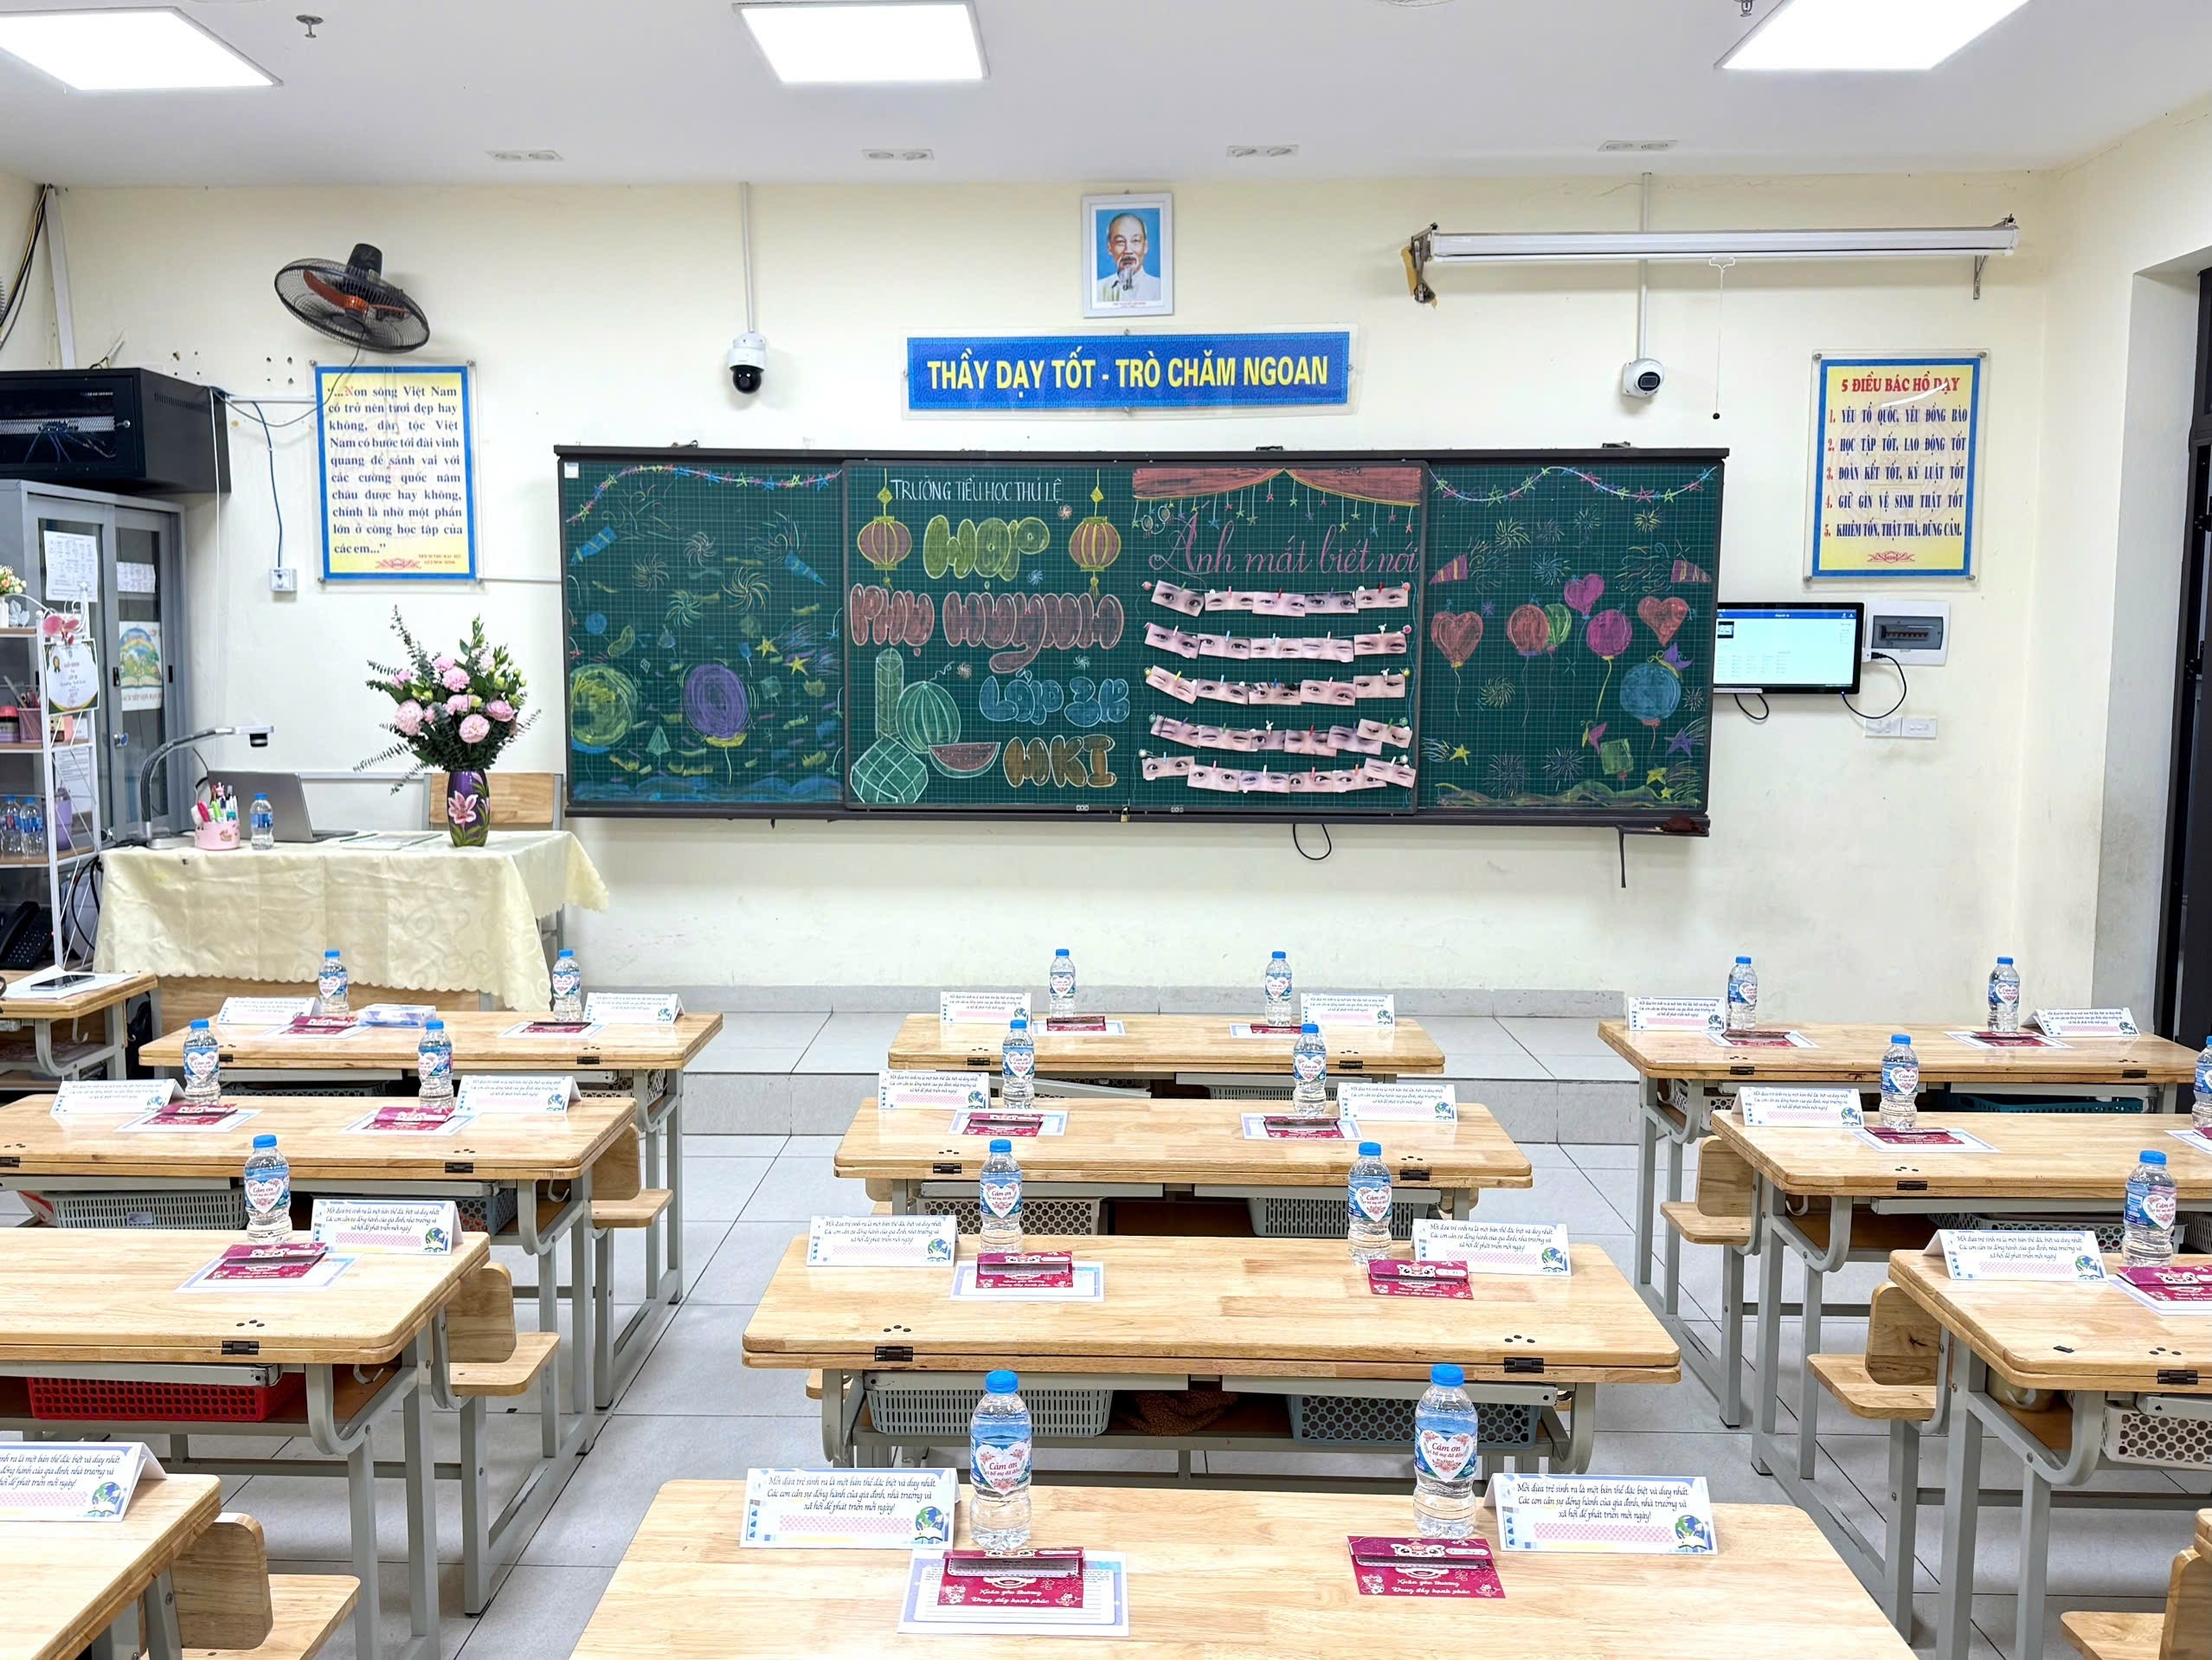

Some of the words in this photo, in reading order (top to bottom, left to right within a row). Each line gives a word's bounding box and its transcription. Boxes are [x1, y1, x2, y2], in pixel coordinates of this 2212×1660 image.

[927, 347, 989, 390] THẦY
[996, 358, 1046, 398] DẠY
[1051, 344, 1094, 389] TỐT
[1115, 351, 1161, 388] TRÒ
[1167, 350, 1236, 387] CHĂM
[1244, 355, 1328, 387] NGOAN
[373, 386, 398, 399] sông
[403, 386, 425, 398] Việt
[431, 386, 457, 396] Nam
[1841, 378, 1849, 392] 5
[1852, 370, 1882, 392] ĐIỀU
[1884, 374, 1910, 392] BÁC
[1913, 370, 1931, 392] HỒ
[1933, 376, 1960, 395] DẠY
[328, 404, 340, 413] có
[344, 402, 361, 413] trở
[364, 403, 384, 413] nên
[389, 402, 410, 413] tươi
[414, 402, 434, 415] đẹp
[438, 402, 457, 415] hay
[1842, 405, 1856, 423] YÊU
[1862, 402, 1872, 423] TỔ
[1905, 405, 1919, 423] YÊU
[1926, 402, 1946, 423] ĐỒNG
[1952, 404, 1968, 422] BÀO
[329, 420, 368, 432] không,
[377, 420, 398, 430] dân
[408, 421, 425, 432] tộc
[435, 420, 458, 433] Việt
[331, 438, 356, 447] Nam
[358, 437, 370, 447] có
[372, 437, 398, 447] bước
[400, 437, 414, 447] tới
[416, 437, 433, 447] đài
[436, 437, 460, 447] vinh
[1840, 438, 1855, 456] HỌC
[1861, 434, 1876, 456] TẬP
[1904, 438, 1919, 452] LAO
[1925, 433, 1945, 455] ĐỘNG
[1951, 430, 1966, 451] TỐT
[331, 457, 365, 467] quang
[370, 452, 383, 465] để
[389, 454, 415, 465] sánh
[421, 454, 437, 465] vai
[443, 454, 460, 465] với
[331, 472, 349, 483] các
[358, 473, 391, 485] cường
[401, 471, 428, 485] quốc
[1838, 462, 1859, 479] ĐOÀN
[1864, 459, 1881, 479] KẾT
[1907, 460, 1919, 479] KỶ
[1924, 462, 1945, 484] LUẬT
[1950, 459, 1965, 479] TỐT
[331, 489, 358, 499] châu
[364, 489, 391, 502] được
[398, 489, 417, 502] hay
[424, 489, 461, 503] không,
[955, 474, 982, 502] TIỂU
[985, 481, 1013, 504] HỌC
[1013, 477, 1041, 502] THỦ
[1045, 478, 1063, 504] LỆ
[1838, 492, 1854, 508] GIỮ
[1858, 491, 1872, 508] GÌN
[1879, 491, 1889, 512] VỆ
[1894, 494, 1914, 508] SINH
[1920, 491, 1942, 512] THẬT
[1947, 487, 1964, 508] TỐT
[332, 506, 363, 517] chính
[368, 506, 378, 517] là
[383, 506, 404, 517] nhờ
[408, 506, 429, 519] một
[333, 524, 350, 534] lớn
[355, 523, 362, 534] ở
[366, 524, 392, 537] công
[397, 524, 416, 537] học
[421, 524, 439, 537] tập
[443, 523, 463, 534] của
[1148, 500, 1237, 578] Ánh
[1246, 535, 1314, 574] mắt
[1320, 524, 1375, 574] biết
[1378, 541, 1419, 574] nói
[1836, 519, 1862, 537] KHIÊM
[1881, 519, 1902, 541] THẬT
[1922, 519, 1942, 537] DŨNG
[334, 543, 352, 553] các
[850, 582, 936, 658] PHỤ
[942, 591, 1124, 674] HUYNH
[979, 667, 1064, 725] LỚP
[1064, 677, 1130, 727] 2B
[1003, 734, 1117, 788] HKI
